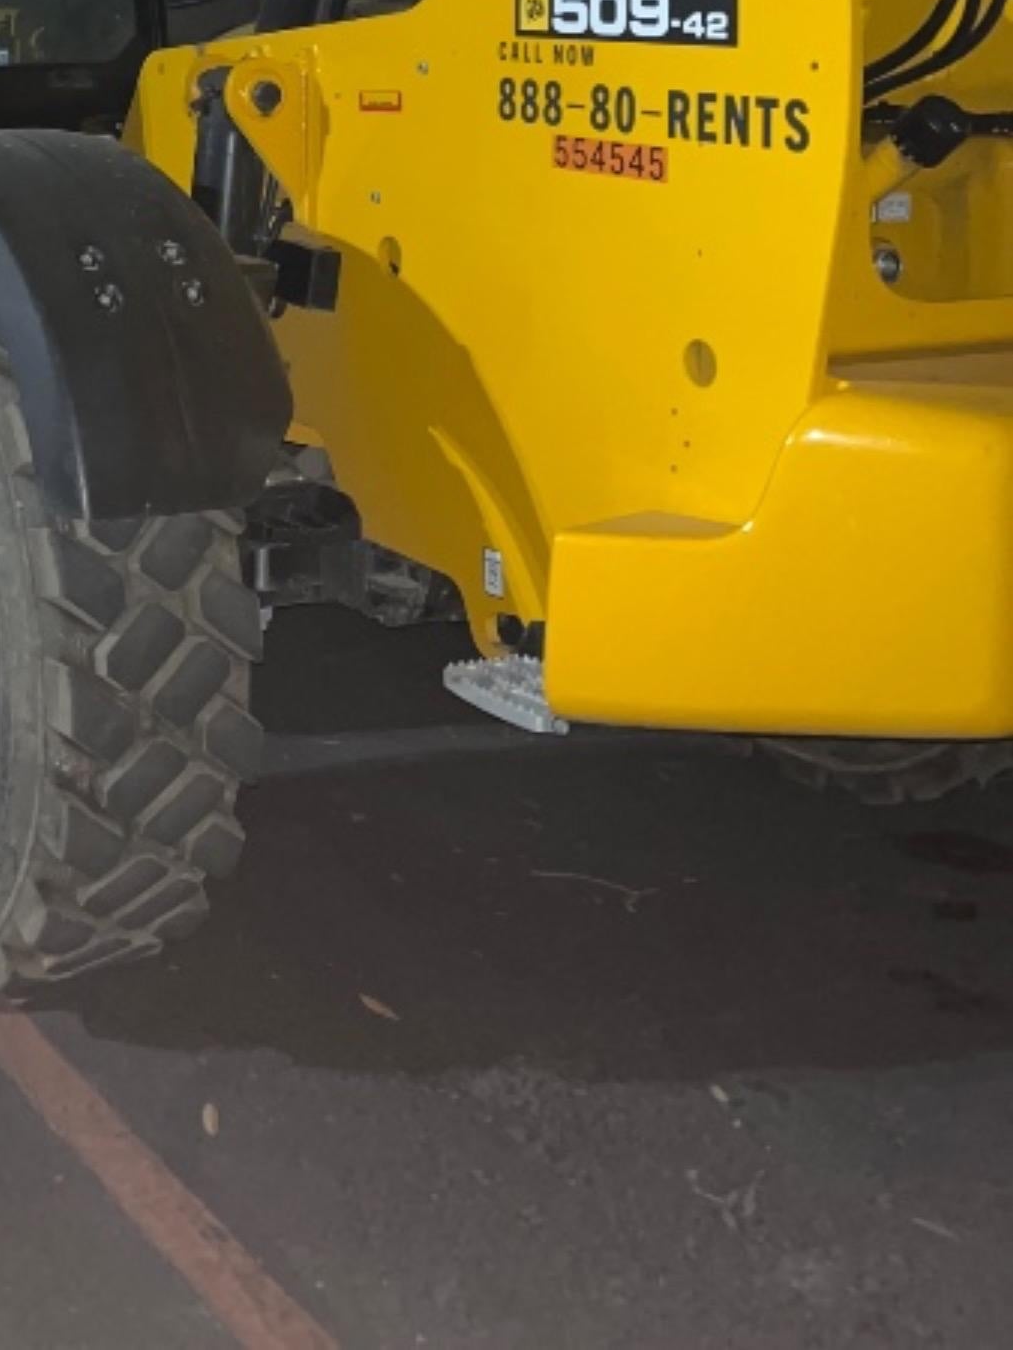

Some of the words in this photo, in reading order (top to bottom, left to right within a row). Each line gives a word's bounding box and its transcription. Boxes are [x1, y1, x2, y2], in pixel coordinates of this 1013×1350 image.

[498, 41, 543, 64] CALL
[553, 43, 595, 66] NOW
[498, 76, 811, 153] 888-80-RENTS
[553, 134, 665, 182] 554545
